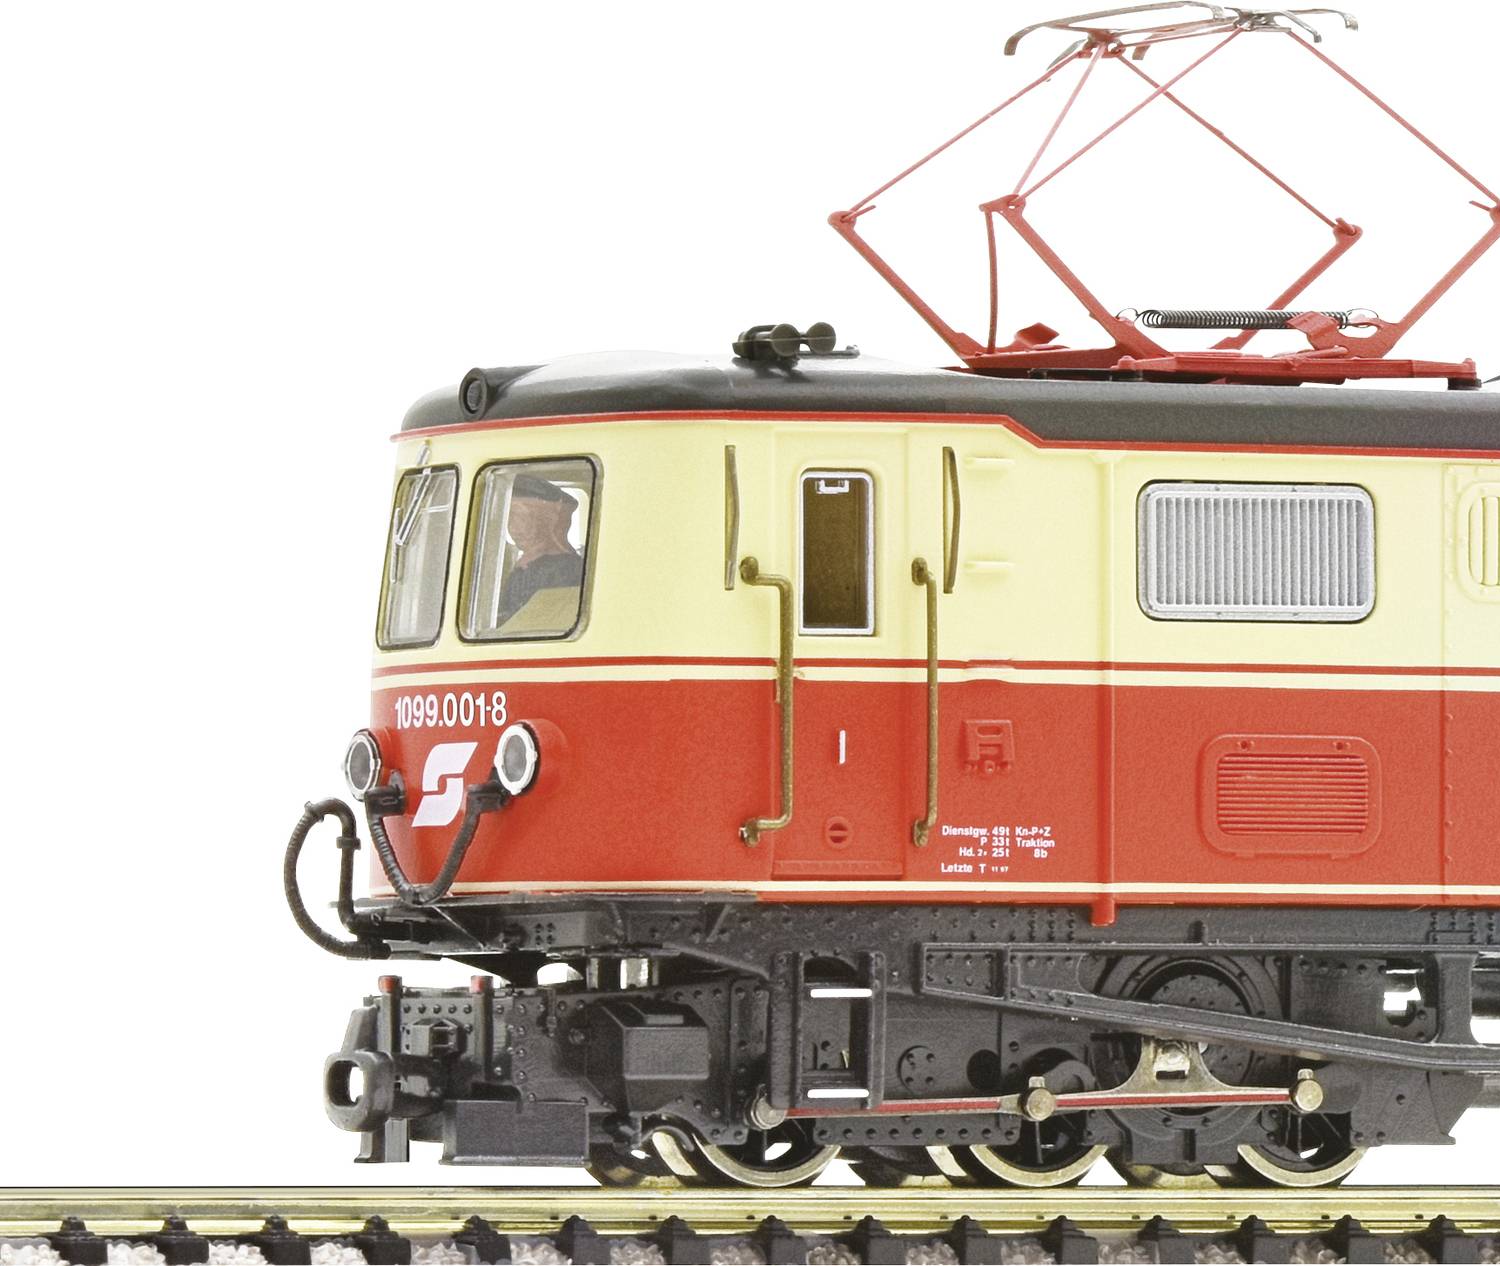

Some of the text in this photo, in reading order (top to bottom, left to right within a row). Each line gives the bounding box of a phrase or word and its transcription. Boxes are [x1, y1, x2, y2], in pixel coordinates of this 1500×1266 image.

[394, 690, 507, 729] 1099.001-8
[941, 824, 990, 838] Dienstgw.
[980, 836, 988, 847] P
[1015, 836, 1056, 848] Traktion
[959, 846, 975, 857] Hd.
[940, 862, 973, 873] Letzte
[978, 863, 987, 874] T
